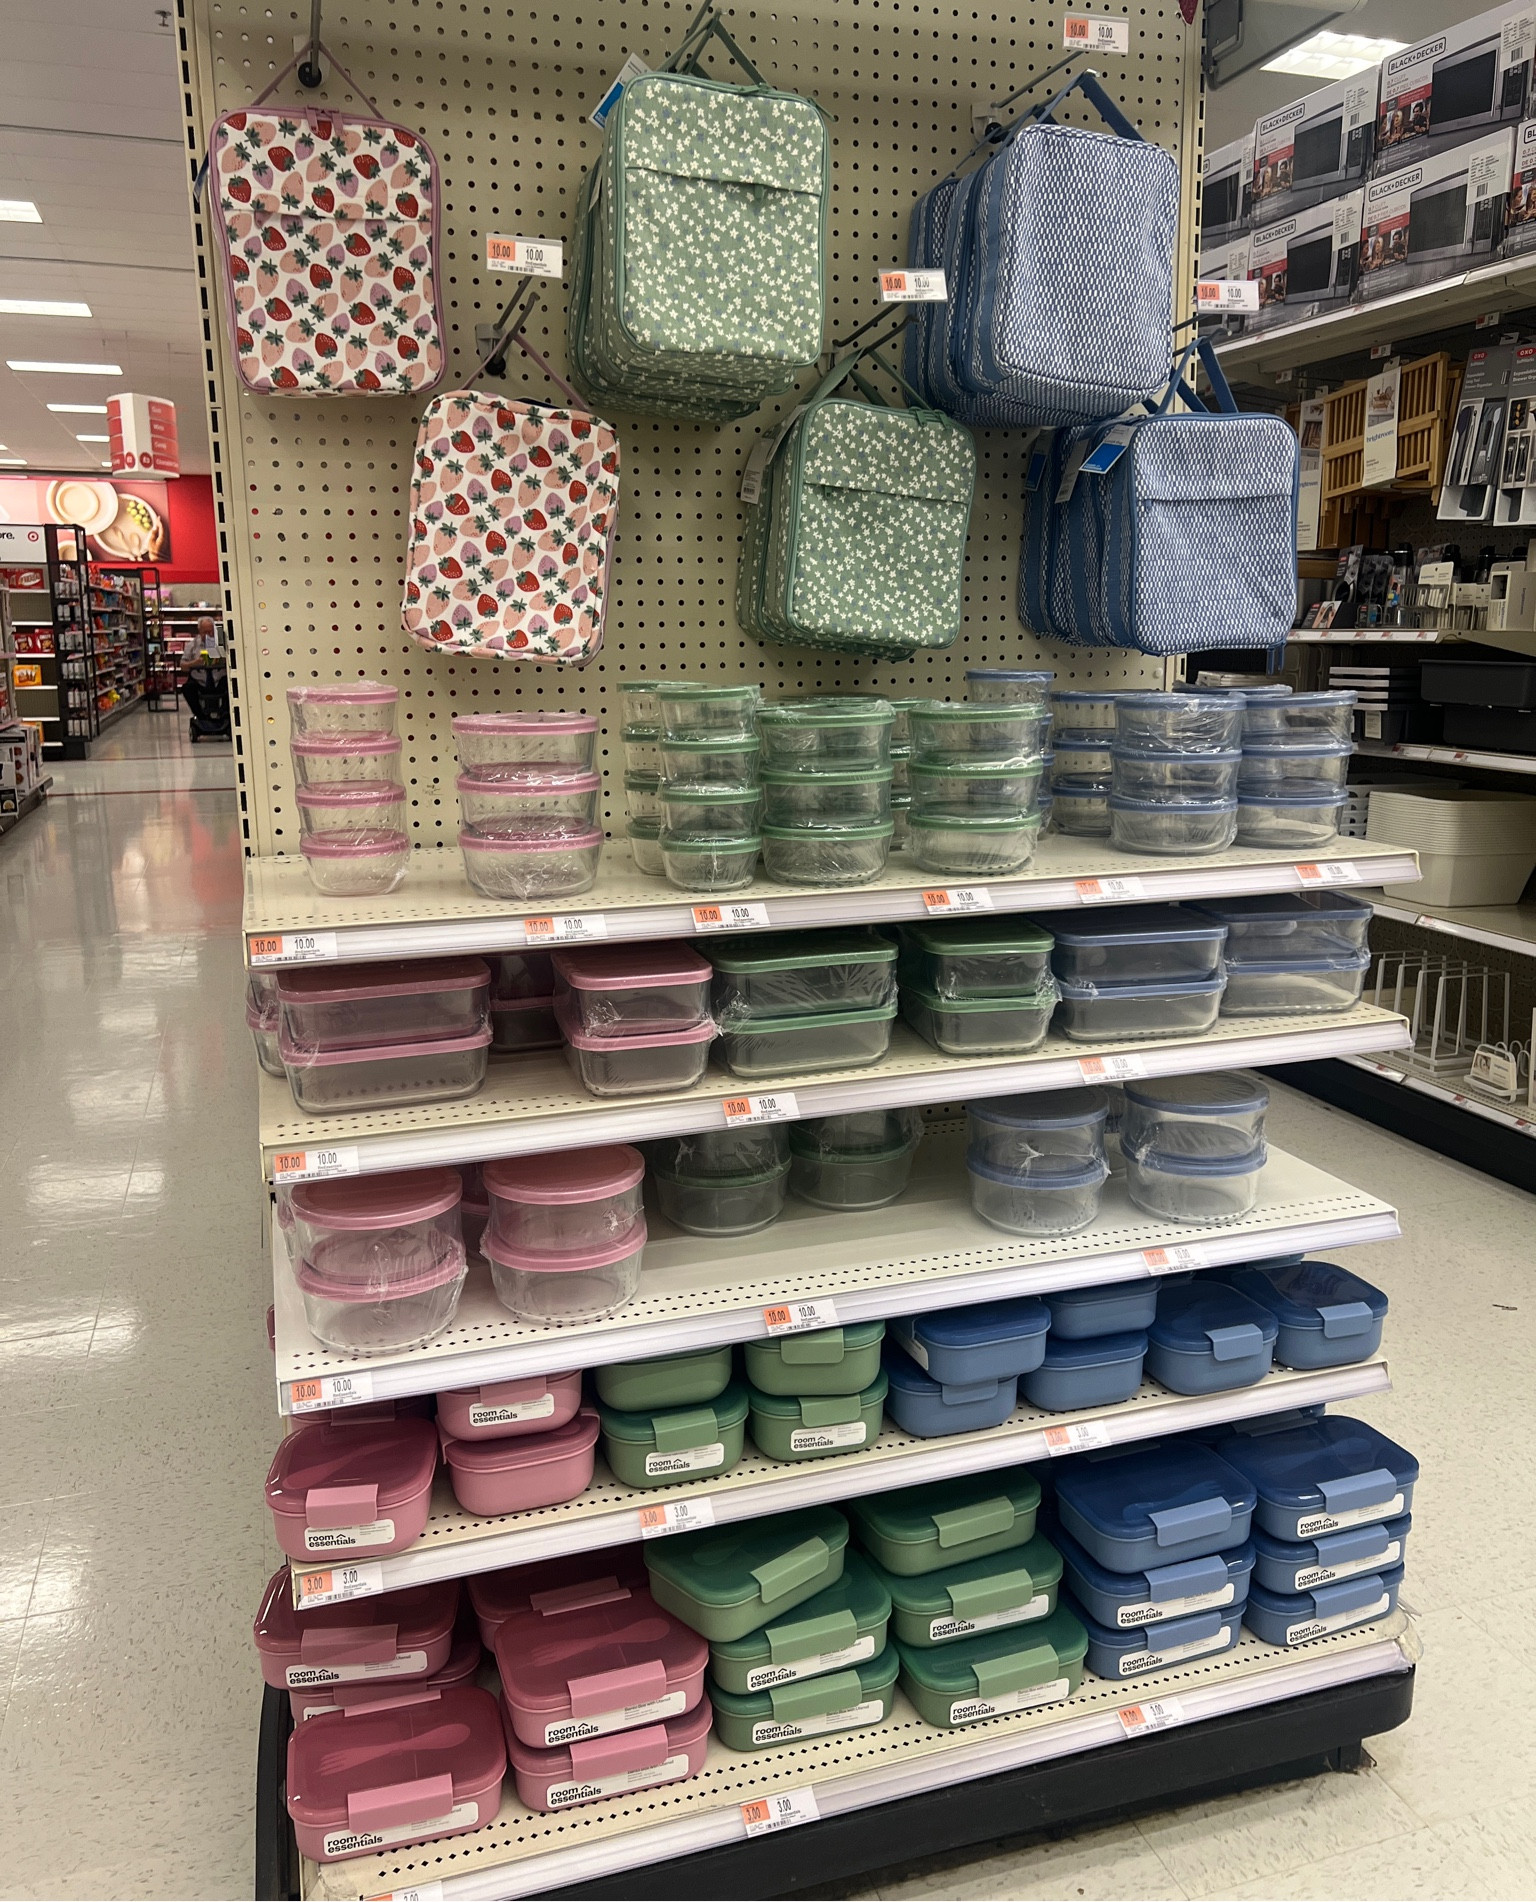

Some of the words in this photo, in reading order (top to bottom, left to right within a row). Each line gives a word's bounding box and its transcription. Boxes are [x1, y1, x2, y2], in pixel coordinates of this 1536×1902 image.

[1099, 27, 1112, 38] 10.00
[1390, 42, 1444, 71] BLACK+DECKER
[1262, 107, 1303, 131] BLACK+DECKER
[1371, 173, 1420, 197] BLACK+DECKER
[1255, 224, 1294, 243] BLACK+DECKER
[493, 243, 510, 258] 10.00
[526, 248, 543, 261] 10.00
[1201, 287, 1217, 297] 10.00
[1227, 288, 1242, 299] 10.00
[699, 910, 718, 921] 10.00
[732, 908, 749, 918] 10.00
[529, 921, 549, 932] 10.00
[564, 919, 583, 930] 10.00
[256, 941, 277, 952] 10.00
[295, 938, 315, 949] 10.00
[728, 1102, 746, 1113] 10.00
[759, 1098, 776, 1109] 10.00
[280, 1157, 300, 1169] 10.00
[317, 1152, 337, 1165] 10.00
[769, 1310, 786, 1322] 10.00
[799, 1306, 816, 1317] 10.00
[296, 1385, 316, 1398] 10.00
[333, 1379, 352, 1392] 10.00
[473, 1410, 497, 1418] room
[473, 1412, 517, 1423] essentials
[794, 1439, 834, 1449] essentials
[649, 1462, 690, 1473] essentials
[643, 1511, 657, 1524] 3.00
[674, 1505, 688, 1518] 3.00
[1300, 1520, 1339, 1534] essentials
[1301, 1520, 1322, 1529] room
[309, 1537, 356, 1548] essentials
[343, 1570, 358, 1584] 3.00
[1298, 1571, 1318, 1581] room
[1298, 1572, 1336, 1587] essentials
[308, 1577, 322, 1591] 3.00
[1121, 1610, 1144, 1618] room
[1121, 1611, 1163, 1624] essentials
[933, 1622, 956, 1632] room
[933, 1622, 975, 1637] essentials
[1290, 1627, 1311, 1637] room
[1290, 1626, 1327, 1642] essentials
[1122, 1657, 1144, 1667] room
[1122, 1657, 1163, 1672] essentials
[289, 1670, 316, 1679] room
[289, 1672, 340, 1684] essentials
[751, 1670, 776, 1682] room
[751, 1669, 797, 1688] essentials
[953, 1705, 976, 1715] room
[953, 1706, 995, 1720] essentials
[548, 1725, 576, 1737] room
[548, 1725, 599, 1743] essentials
[755, 1726, 781, 1735] room
[755, 1727, 802, 1741] essentials
[551, 1787, 578, 1799] room
[551, 1787, 602, 1805] essentials
[777, 1799, 791, 1813] 3.00
[746, 1807, 761, 1821] 3.00
[327, 1836, 357, 1847] room
[327, 1835, 383, 1853] essentials
